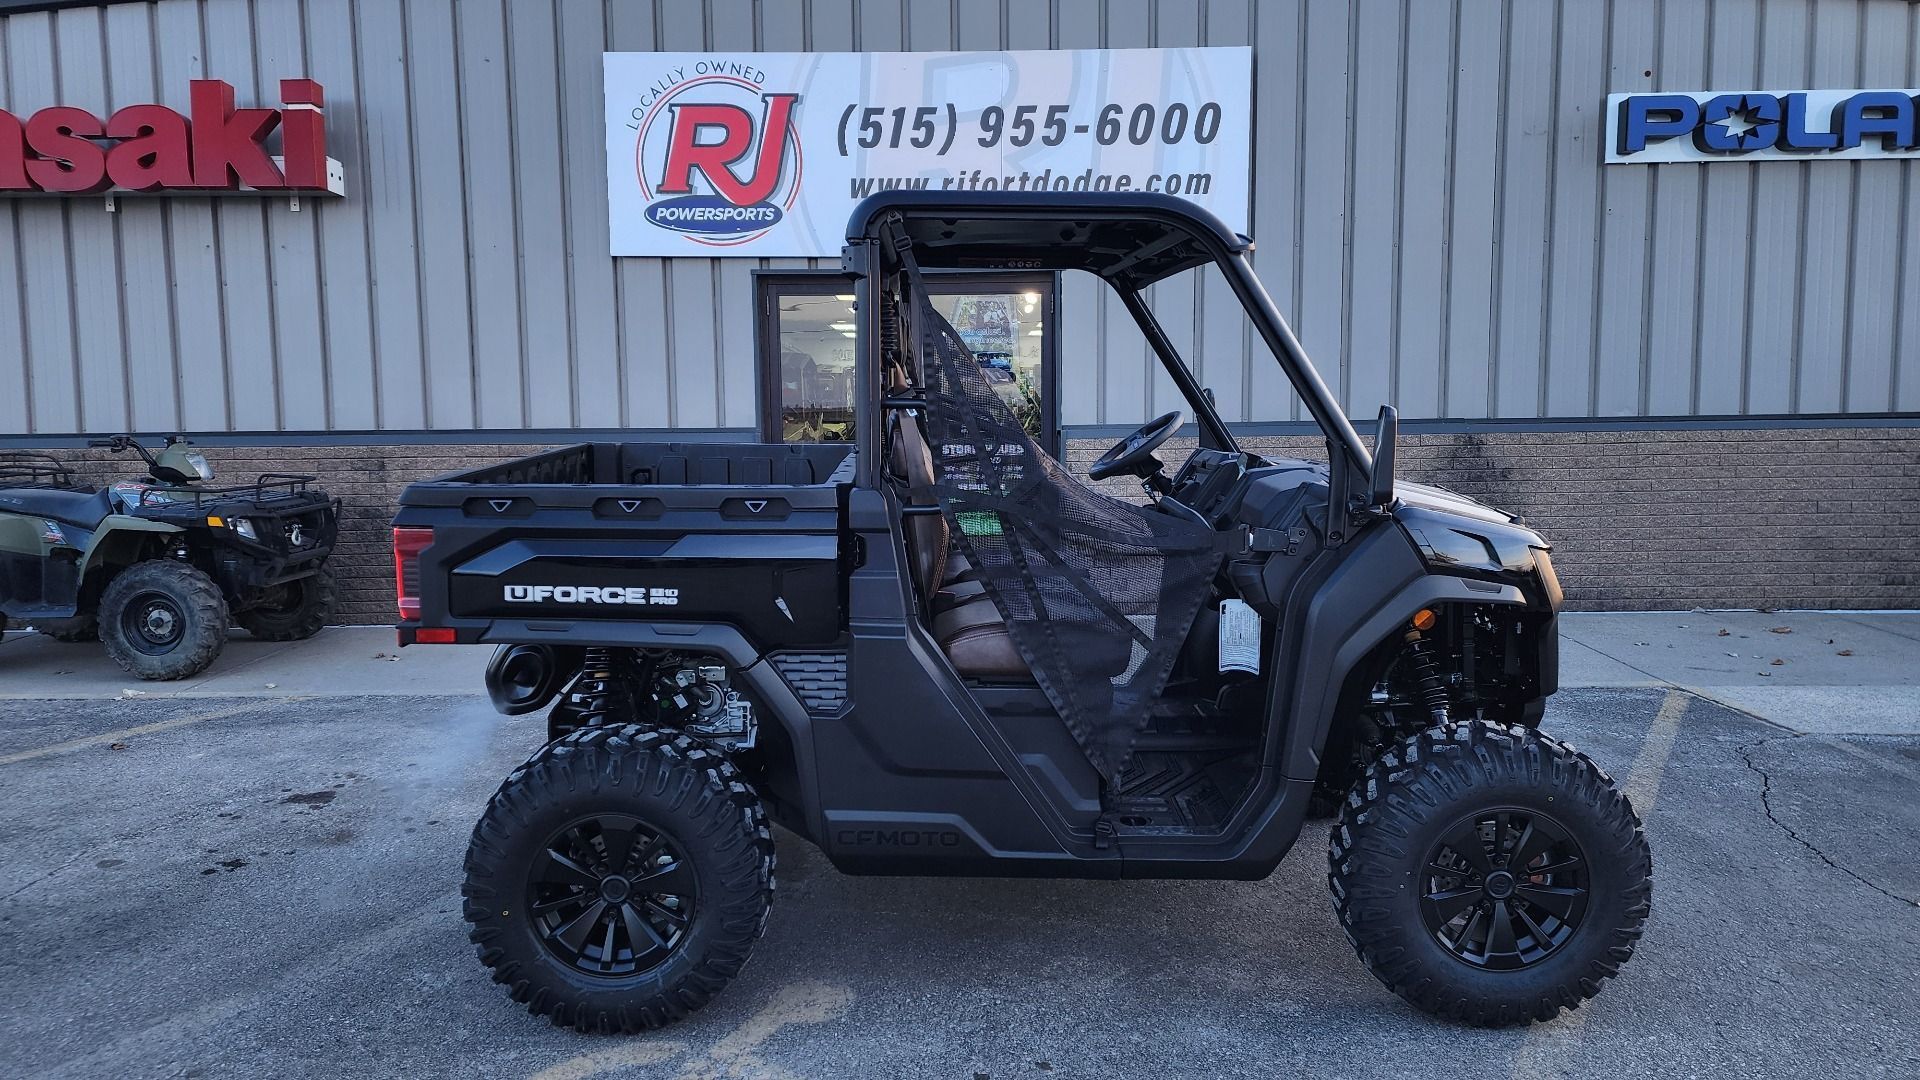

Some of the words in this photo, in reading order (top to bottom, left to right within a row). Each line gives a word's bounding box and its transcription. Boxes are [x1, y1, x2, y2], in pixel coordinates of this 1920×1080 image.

[626, 66, 686, 130] LOCALLY
[695, 60, 766, 84] OWNED
[0, 78, 325, 192] saki
[837, 102, 958, 157] (515)
[977, 101, 1222, 148] 955-6000
[1616, 91, 1920, 154] POLA
[655, 92, 803, 207] RJ
[850, 168, 1212, 199] wwwrfortdodge.com
[655, 207, 775, 221] POWERSPORTS
[942, 444, 977, 455] STOR
[503, 585, 647, 605] UFORCE
[836, 829, 961, 847] CFMOTO
